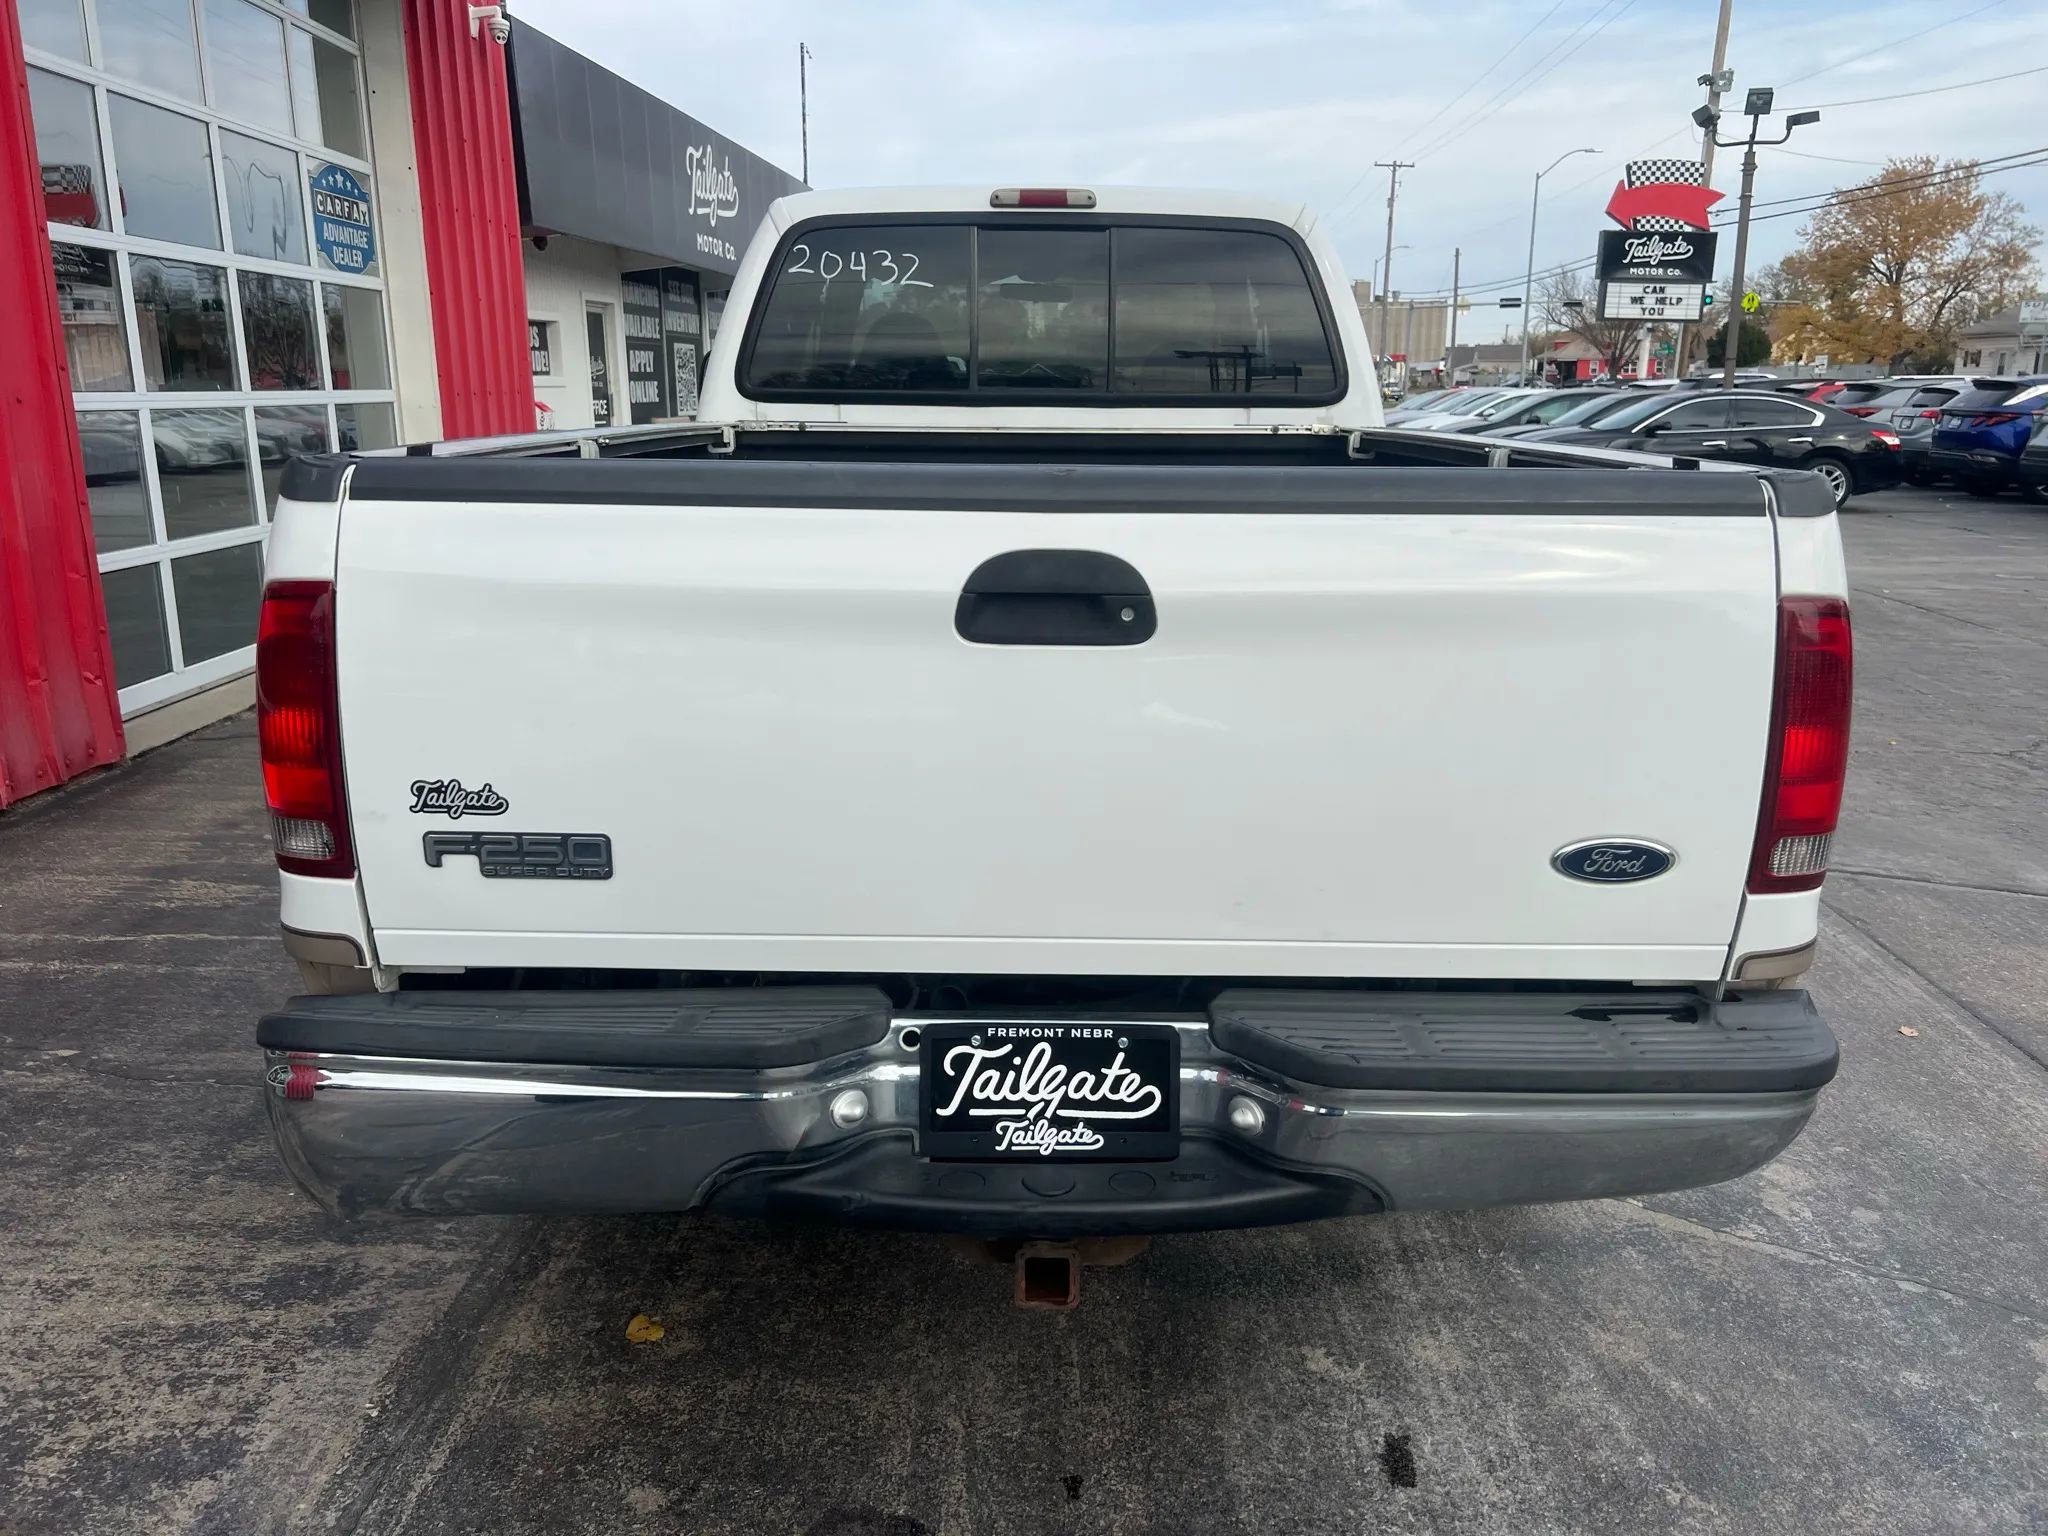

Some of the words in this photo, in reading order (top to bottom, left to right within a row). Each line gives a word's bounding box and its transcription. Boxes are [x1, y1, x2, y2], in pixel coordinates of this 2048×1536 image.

[686, 144, 739, 227] Tailgate
[316, 194, 369, 225] CARFAX
[323, 222, 369, 249] ADVANTAGE
[696, 233, 723, 258] MOTOR
[333, 246, 364, 268] DEALER
[1622, 235, 1694, 265] Tailgate
[788, 245, 935, 288] 20432
[1629, 267, 1664, 276] MOTOR
[1630, 296, 1646, 305] WE
[1654, 296, 1683, 306] HELP
[1643, 286, 1666, 295] CAN
[1641, 307, 1665, 316] YOU
[629, 350, 655, 373] APPLY
[630, 381, 660, 404] ONLINE
[410, 779, 509, 820] Tailgate
[482, 866, 549, 877] SUPER
[555, 867, 610, 878] DUTY
[1583, 848, 1647, 872] Ford
[987, 1027, 1064, 1039] FREMONT
[1071, 1028, 1113, 1039] NEBR
[936, 1041, 1162, 1120] Tailgate
[995, 1119, 1104, 1156] Tailgate
